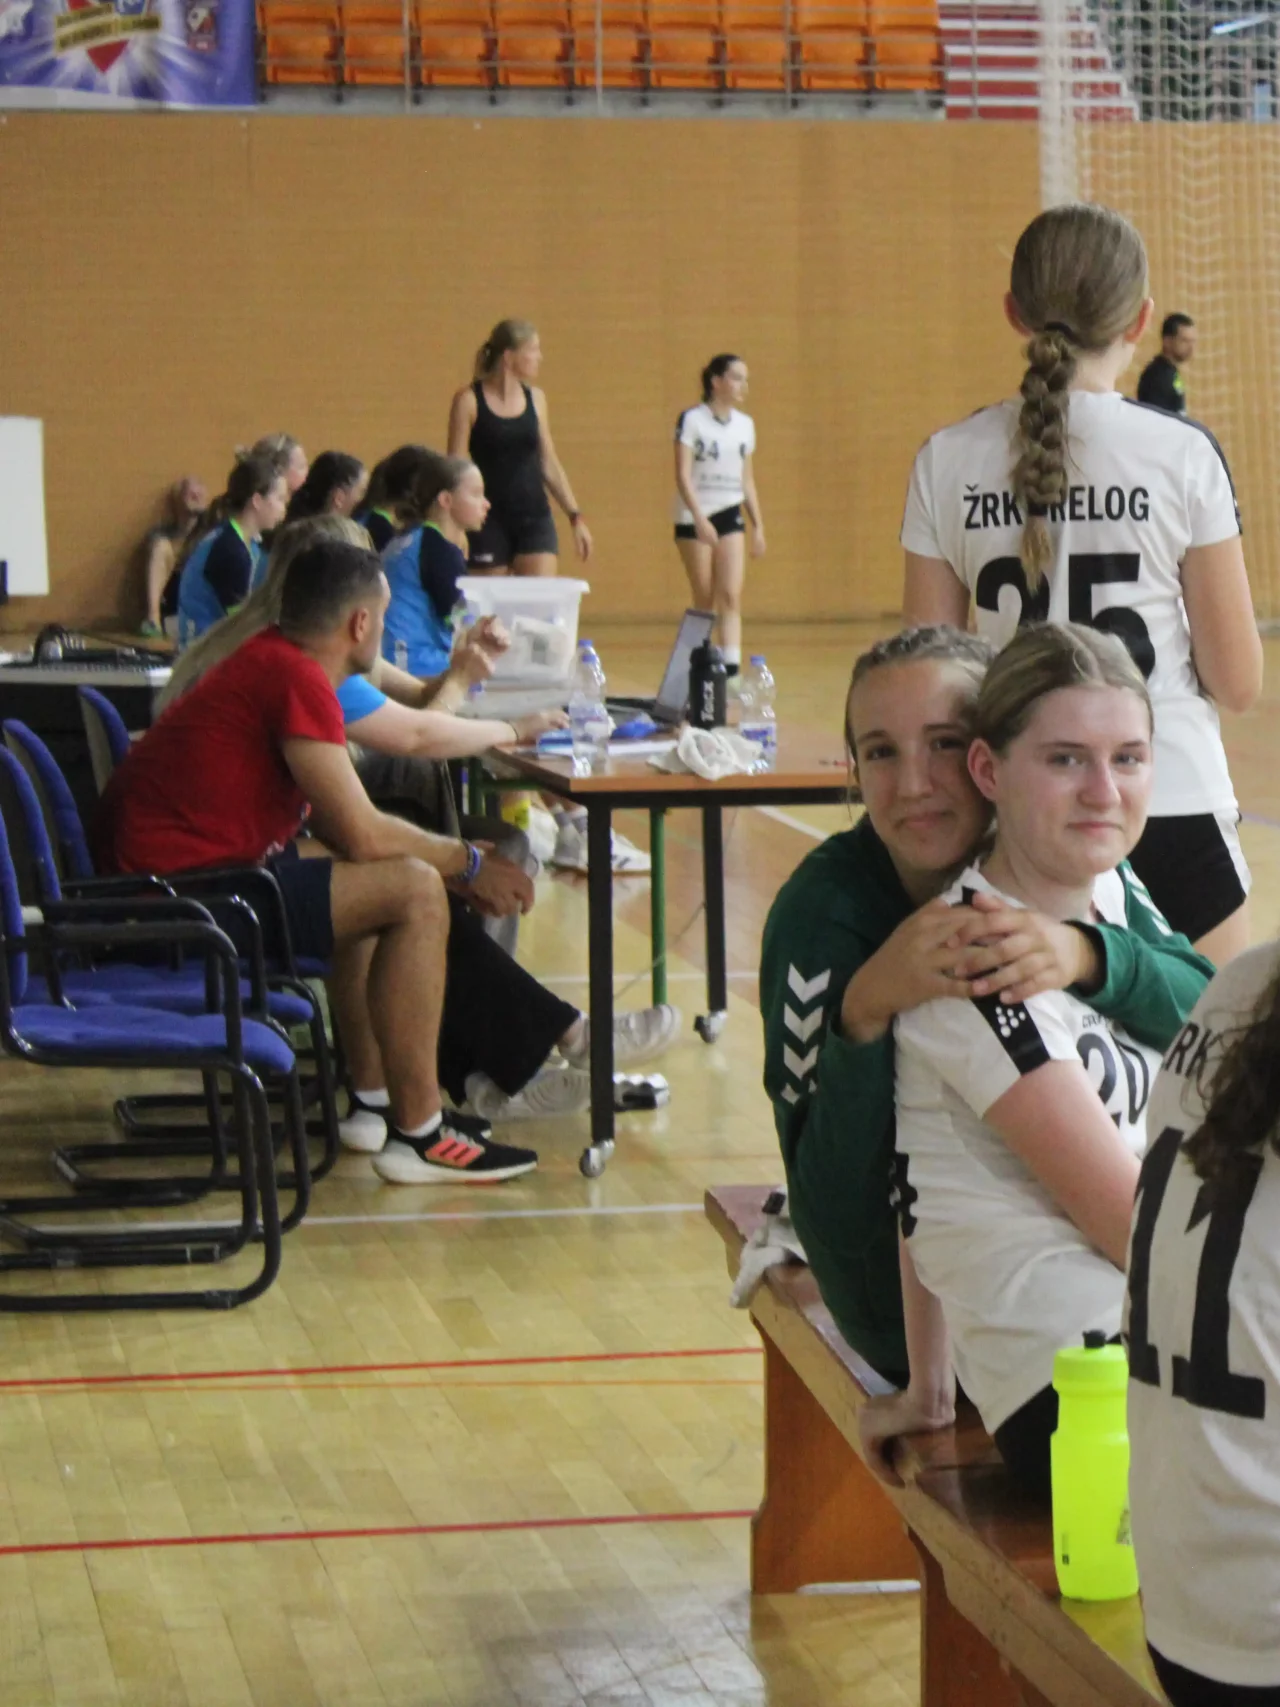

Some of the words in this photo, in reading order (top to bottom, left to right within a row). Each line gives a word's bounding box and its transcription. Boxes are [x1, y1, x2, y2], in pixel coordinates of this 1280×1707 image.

[963, 484, 1023, 530] ŽRK
[1049, 485, 1149, 523] RELOG
[1161, 1022, 1222, 1081] RK
[1129, 1125, 1265, 1420] 11
